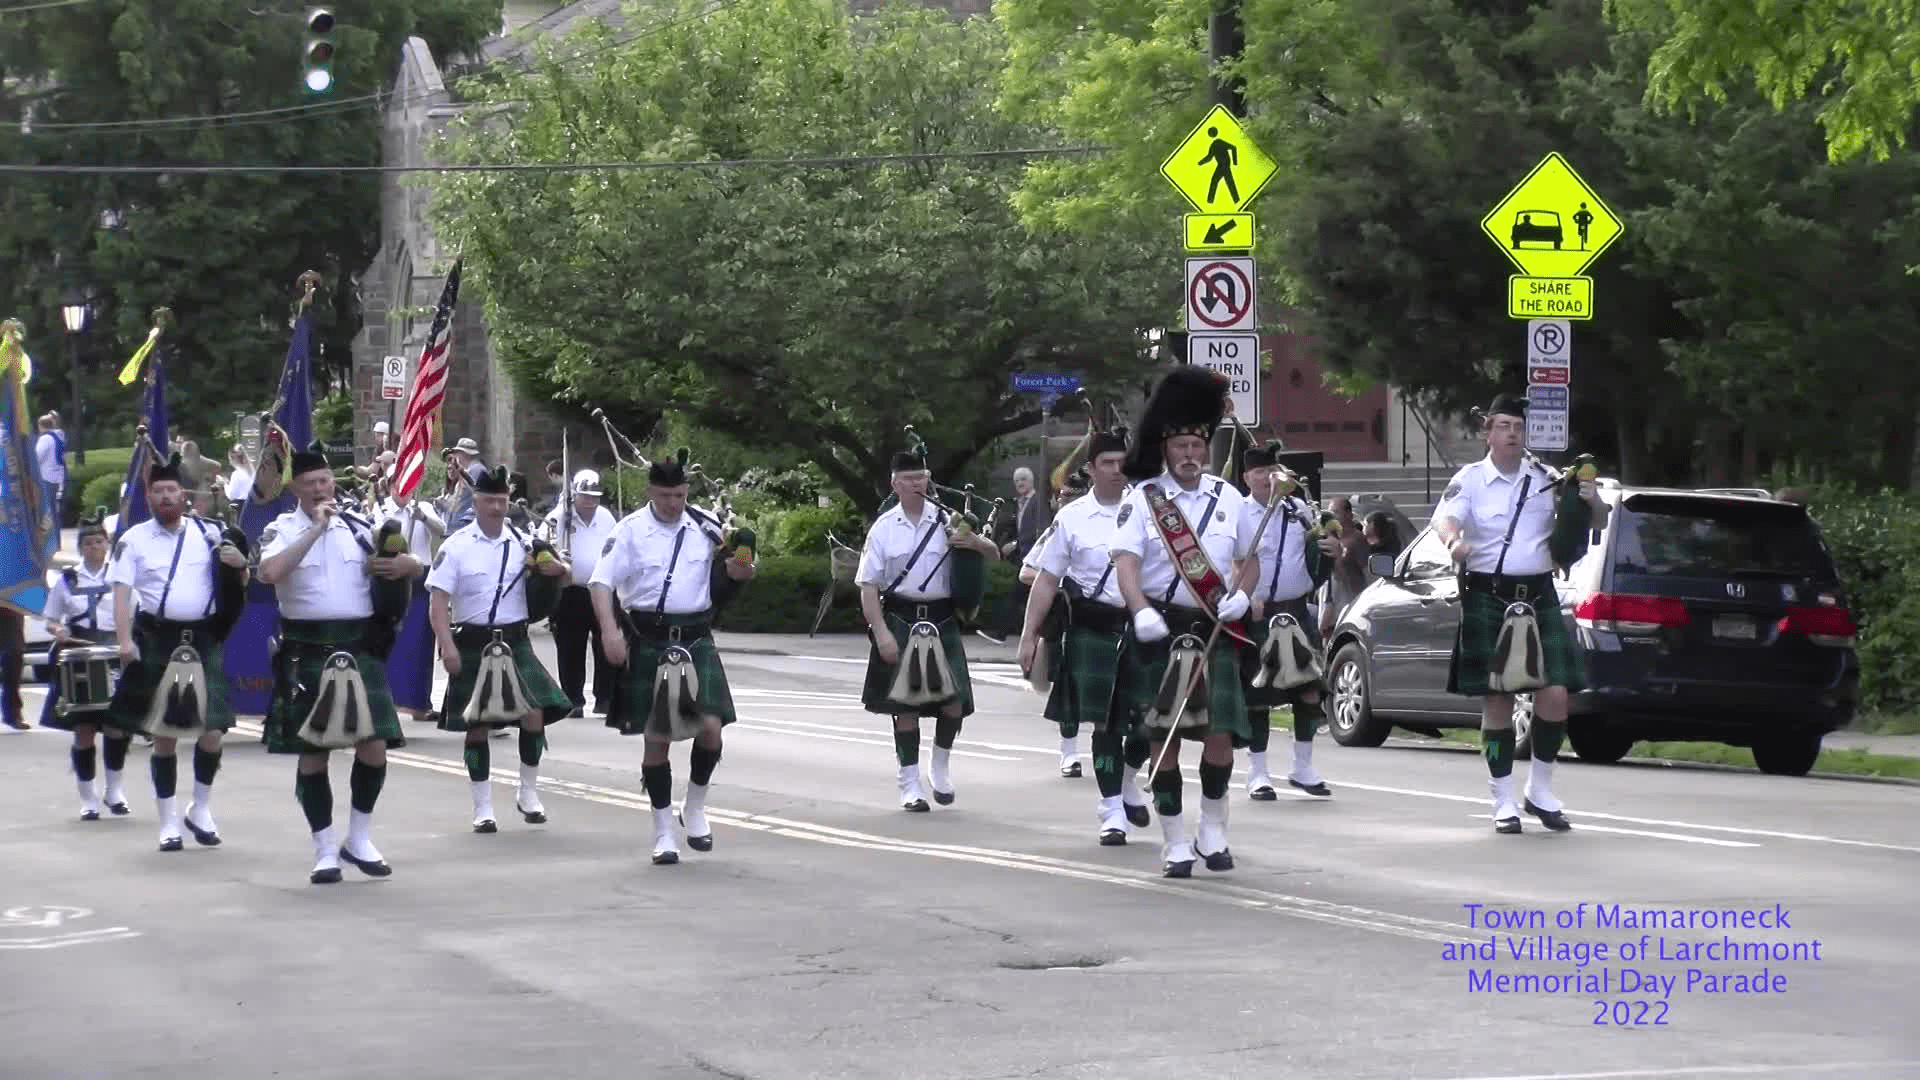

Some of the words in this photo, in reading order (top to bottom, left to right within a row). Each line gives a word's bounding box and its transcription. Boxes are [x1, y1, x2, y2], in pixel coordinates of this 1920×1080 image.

[1530, 281, 1572, 296] SHARE
[1520, 299, 1543, 312] THE
[1547, 299, 1582, 313] ROAD
[1208, 342, 1239, 358] NO
[1015, 376, 1044, 386] Forest
[1046, 376, 1068, 386] Park
